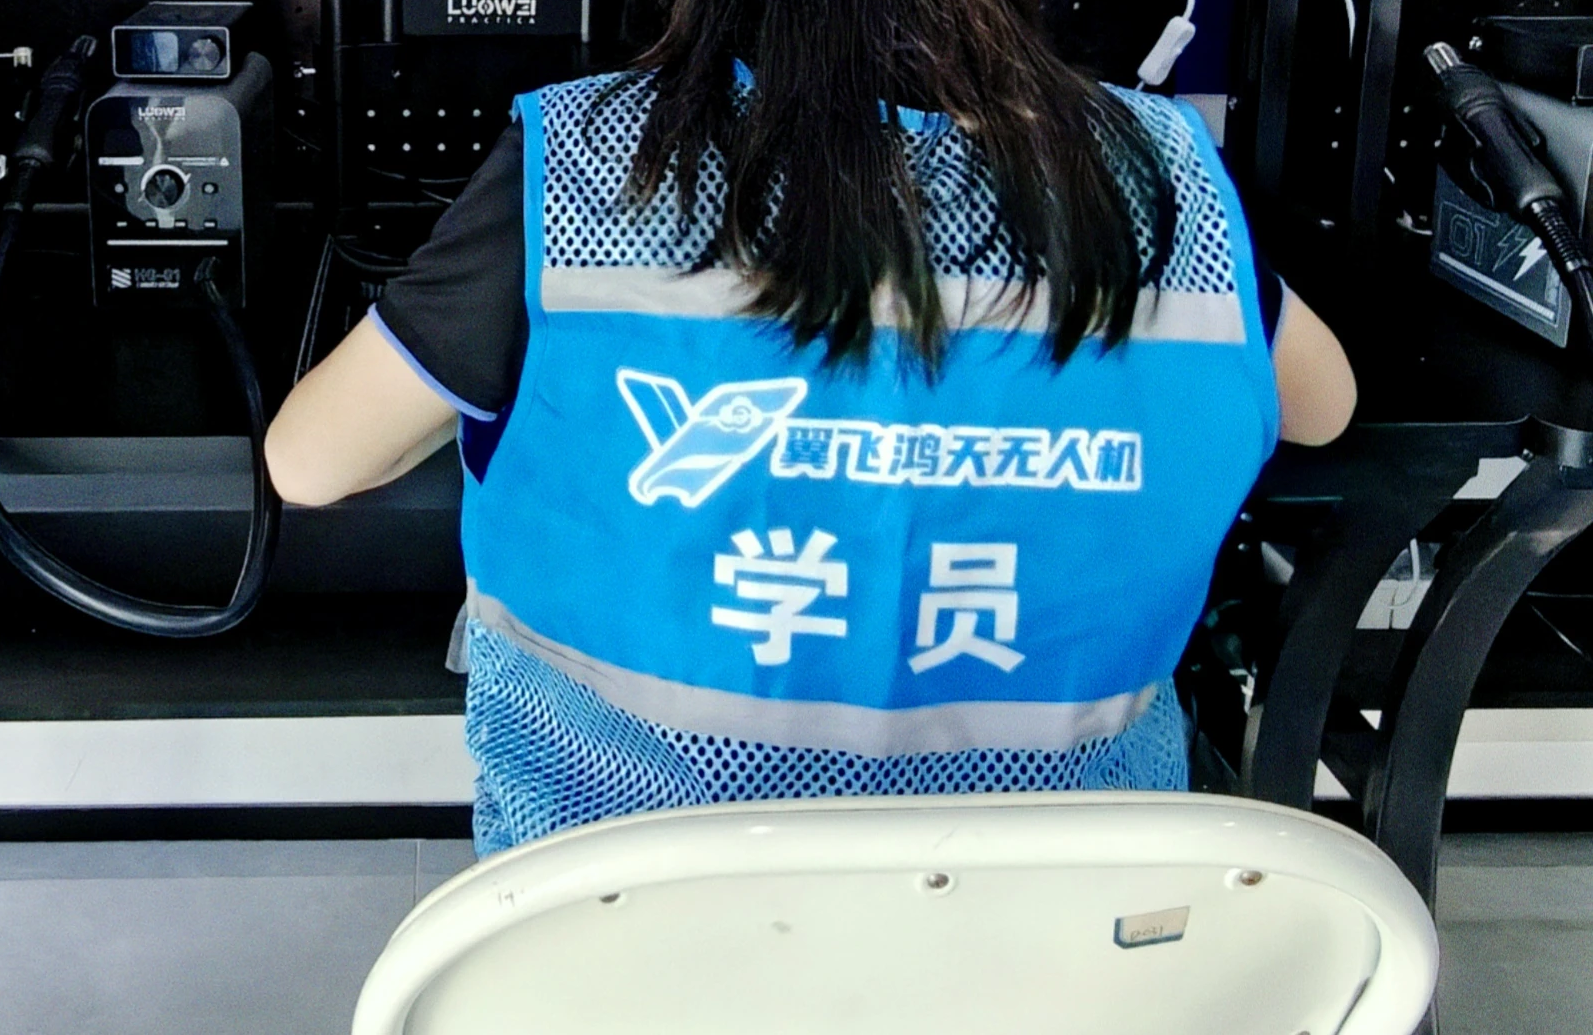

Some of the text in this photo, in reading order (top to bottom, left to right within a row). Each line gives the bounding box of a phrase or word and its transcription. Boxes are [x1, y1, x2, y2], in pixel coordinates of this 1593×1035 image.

[774, 421, 1140, 488] 翼飞鸿天无人机
[711, 528, 1025, 674] 学员
